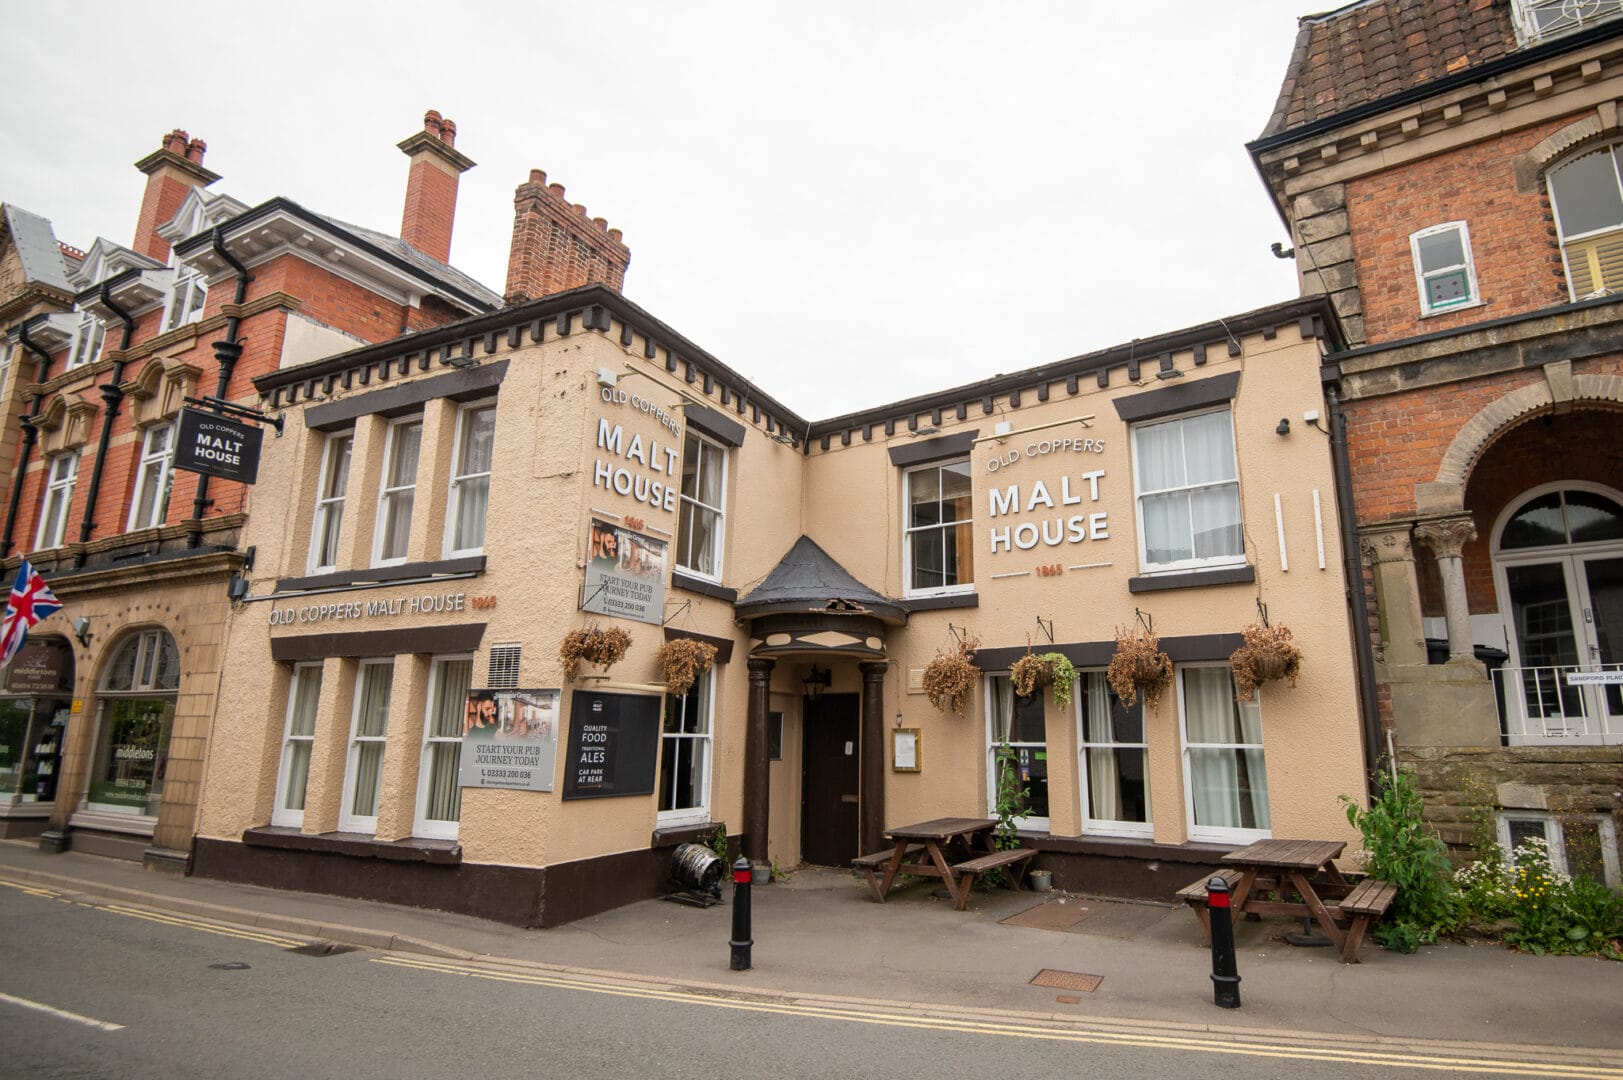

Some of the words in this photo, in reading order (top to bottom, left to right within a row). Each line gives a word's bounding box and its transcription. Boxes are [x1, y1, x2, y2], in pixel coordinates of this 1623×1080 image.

[601, 388, 627, 404] OLD
[630, 394, 681, 437] COPPERS
[215, 425, 244, 439] COPPERS
[197, 433, 243, 453] MALT
[598, 417, 679, 476] MALT
[194, 446, 241, 465] HOUSE
[987, 449, 1020, 472] OLD
[1025, 438, 1105, 457] COPPERS
[594, 459, 676, 512] HOUSE
[989, 469, 1106, 517] MALT
[990, 511, 1110, 554] HOUSE
[1035, 563, 1063, 578] 1865
[600, 574, 620, 586] START
[621, 579, 639, 590] YOUR
[639, 583, 653, 594] PUB
[630, 591, 652, 603] TODAY
[269, 609, 295, 625] OLD
[300, 601, 362, 622] COPPERS
[366, 598, 406, 617] MALT
[410, 593, 465, 613] HOUSE
[471, 595, 497, 609] 1865
[625, 602, 634, 610] 200
[582, 733, 607, 742] FOOD
[116, 745, 154, 759] middletons
[477, 744, 501, 754] START
[503, 745, 524, 755] YOUR
[525, 746, 541, 755] PUB
[580, 752, 605, 763] ALES
[475, 755, 513, 765] JOURNEY
[514, 756, 540, 766] TODAY
[487, 769, 506, 778] 03333
[507, 770, 519, 778] 200
